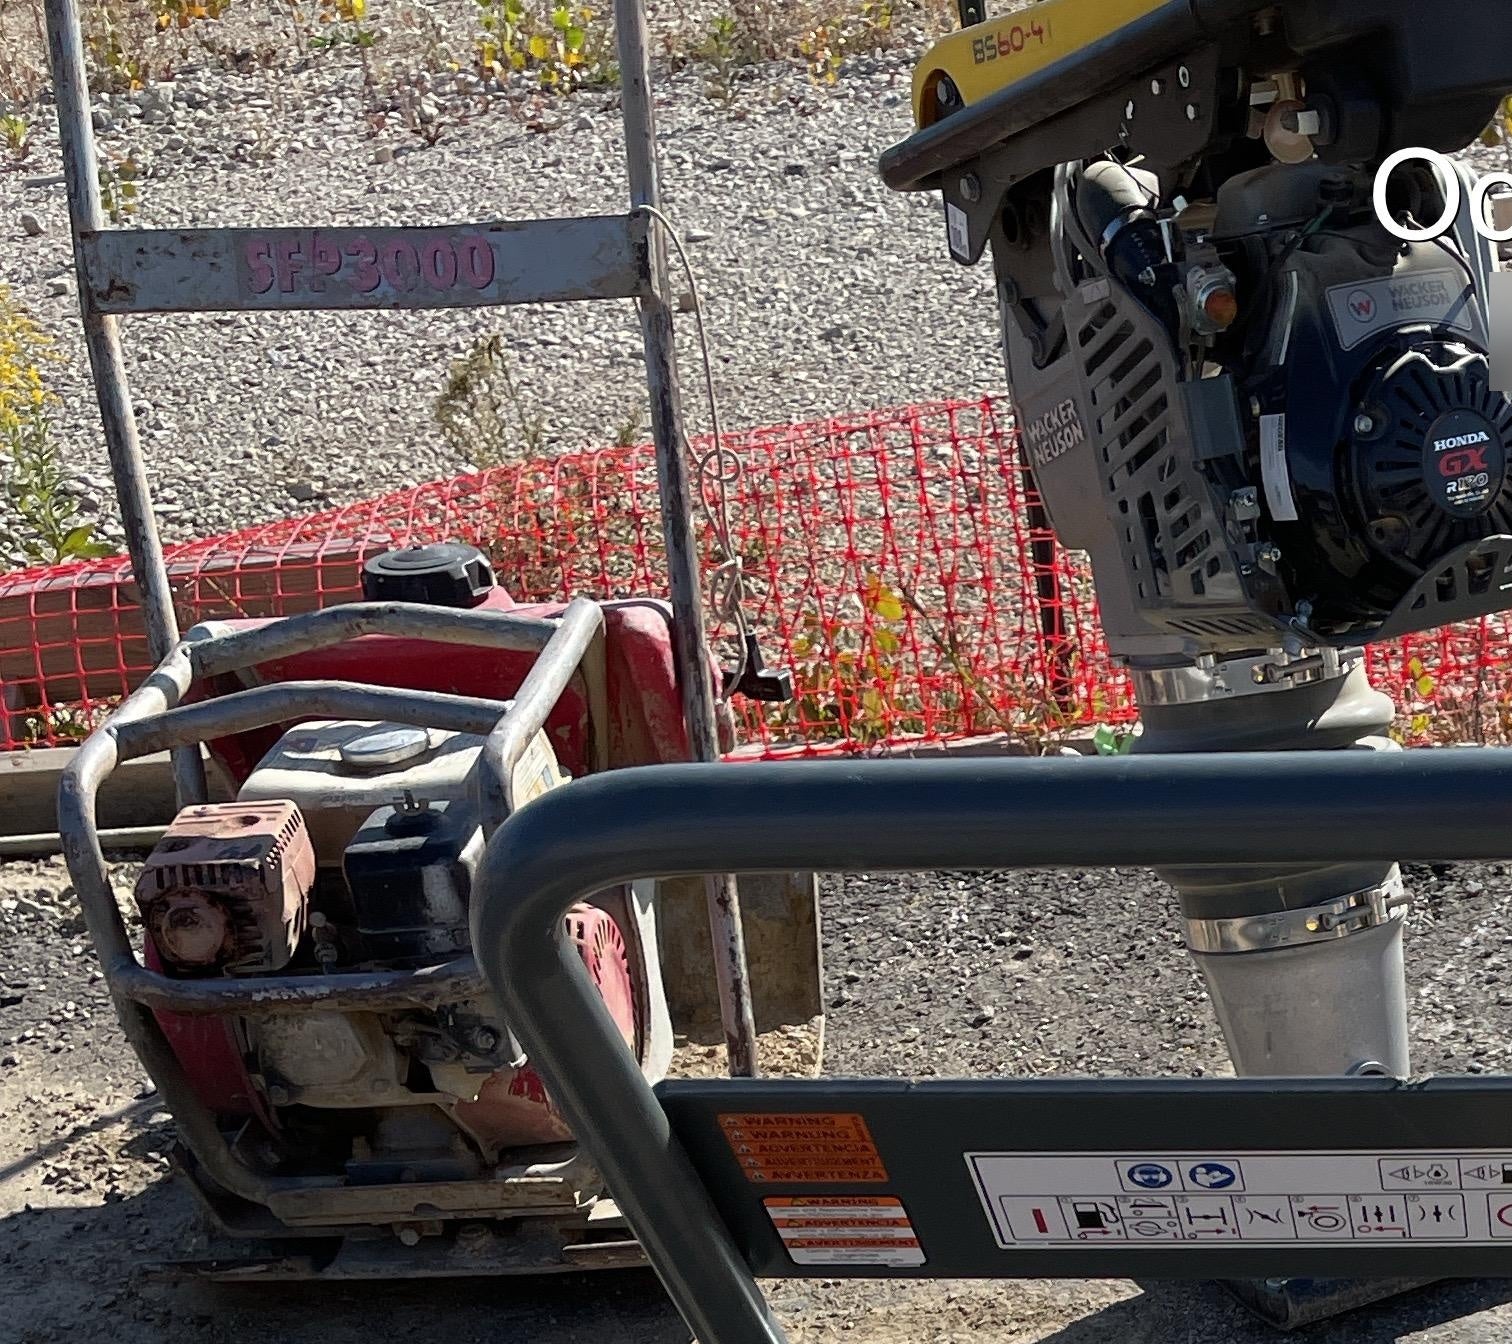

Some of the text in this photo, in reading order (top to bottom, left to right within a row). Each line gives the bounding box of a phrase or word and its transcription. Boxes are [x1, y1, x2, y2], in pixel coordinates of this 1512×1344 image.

[1026, 398, 1077, 443] WACKER
[1033, 419, 1085, 467] NEUSON
[1433, 431, 1490, 452] HONDA
[1439, 446, 1489, 477] GX
[744, 1116, 836, 1127] WARNING
[750, 1130, 850, 1140] WARNUNG
